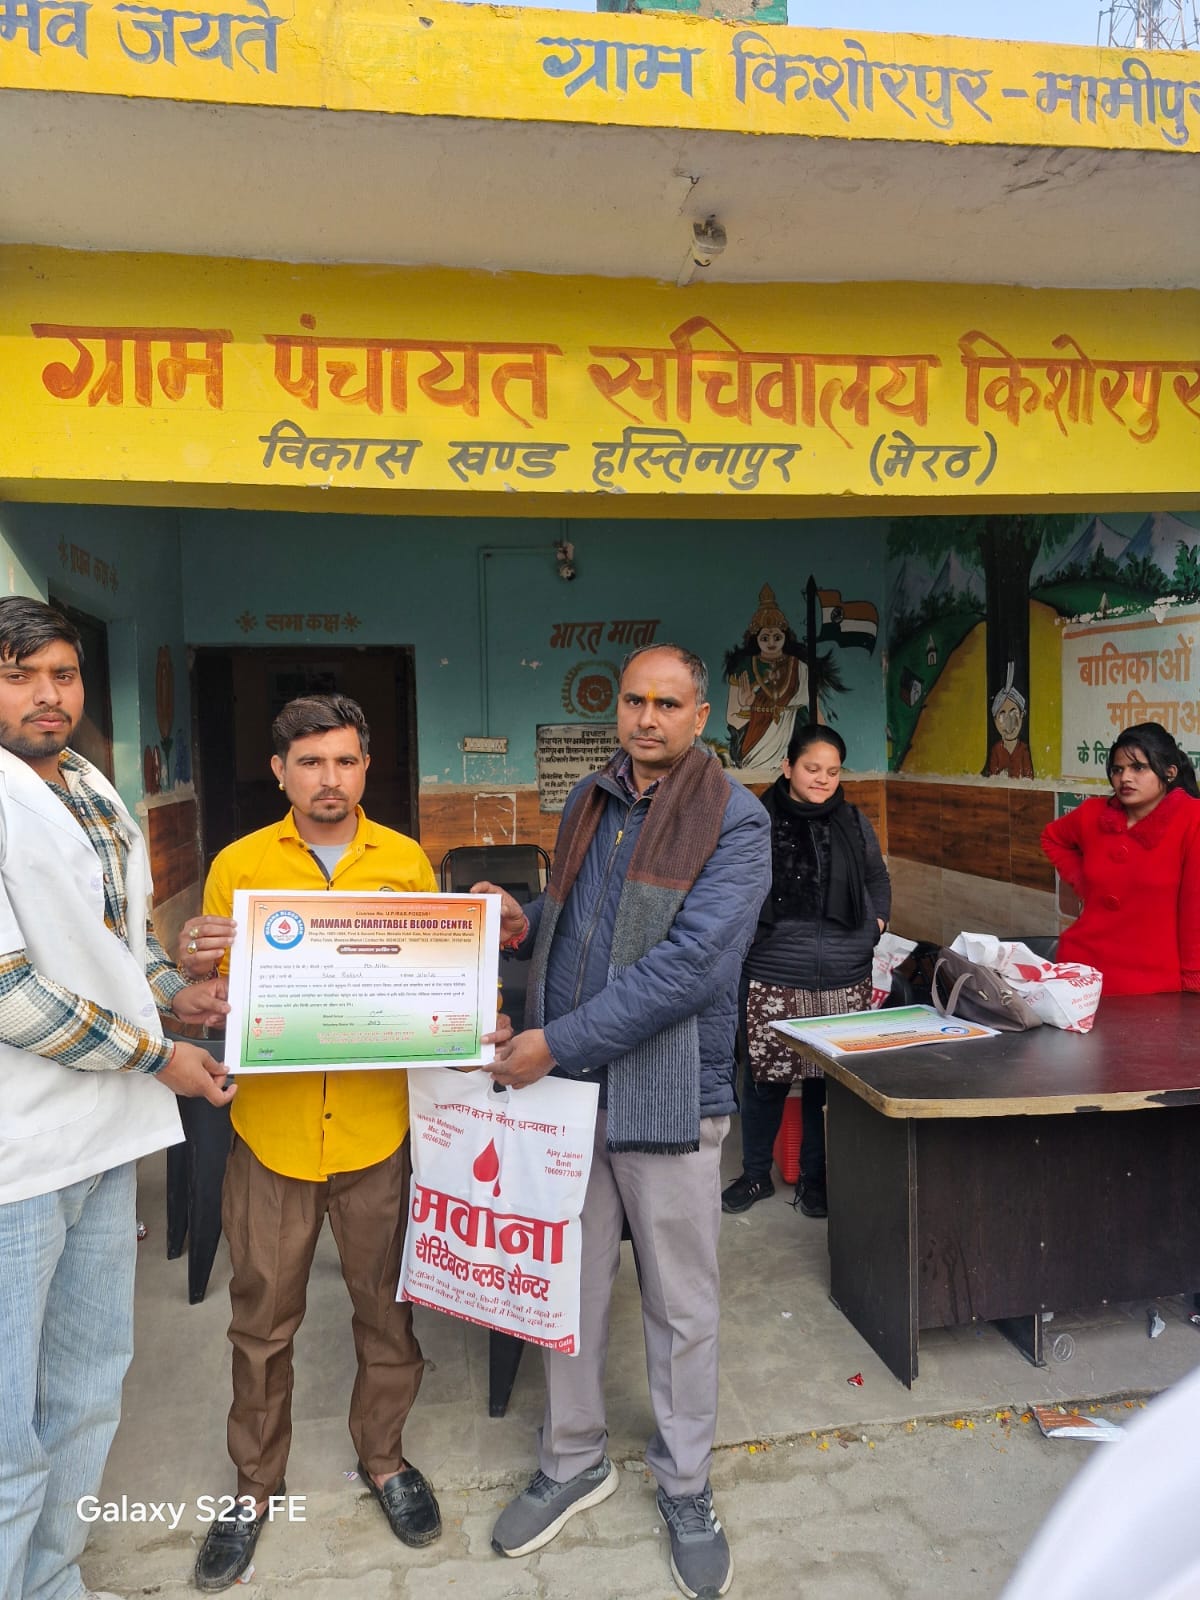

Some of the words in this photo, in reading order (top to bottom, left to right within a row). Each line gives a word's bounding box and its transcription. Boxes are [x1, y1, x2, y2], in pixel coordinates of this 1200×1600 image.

[113, 0, 288, 74] जयते
[536, 36, 705, 97] ग्राम
[730, 30, 993, 130] किशोरपुर
[31, 323, 233, 411] ग्राम
[264, 313, 563, 429] पंचायत
[586, 316, 942, 450] सचिवालय
[259, 418, 423, 480] विकास
[447, 441, 569, 482] खण्ड
[591, 426, 802, 490] हस्तिनापुर
[869, 431, 998, 486] (मेरठ)
[550, 622, 606, 654] भारत
[608, 619, 661, 648] माता
[1078, 633, 1195, 686] बालिकाओं
[1077, 739, 1090, 765] के
[310, 918, 352, 929] MAWANA
[354, 919, 407, 929] CHARITABLE
[410, 919, 438, 929] BLOOD
[441, 920, 473, 929] CENTRE
[519, 1120, 558, 1136] धन्यवाद
[412, 1182, 569, 1264] मवाना
[416, 1232, 471, 1281] चैरिटेबल
[507, 1262, 550, 1301] सैन्टर
